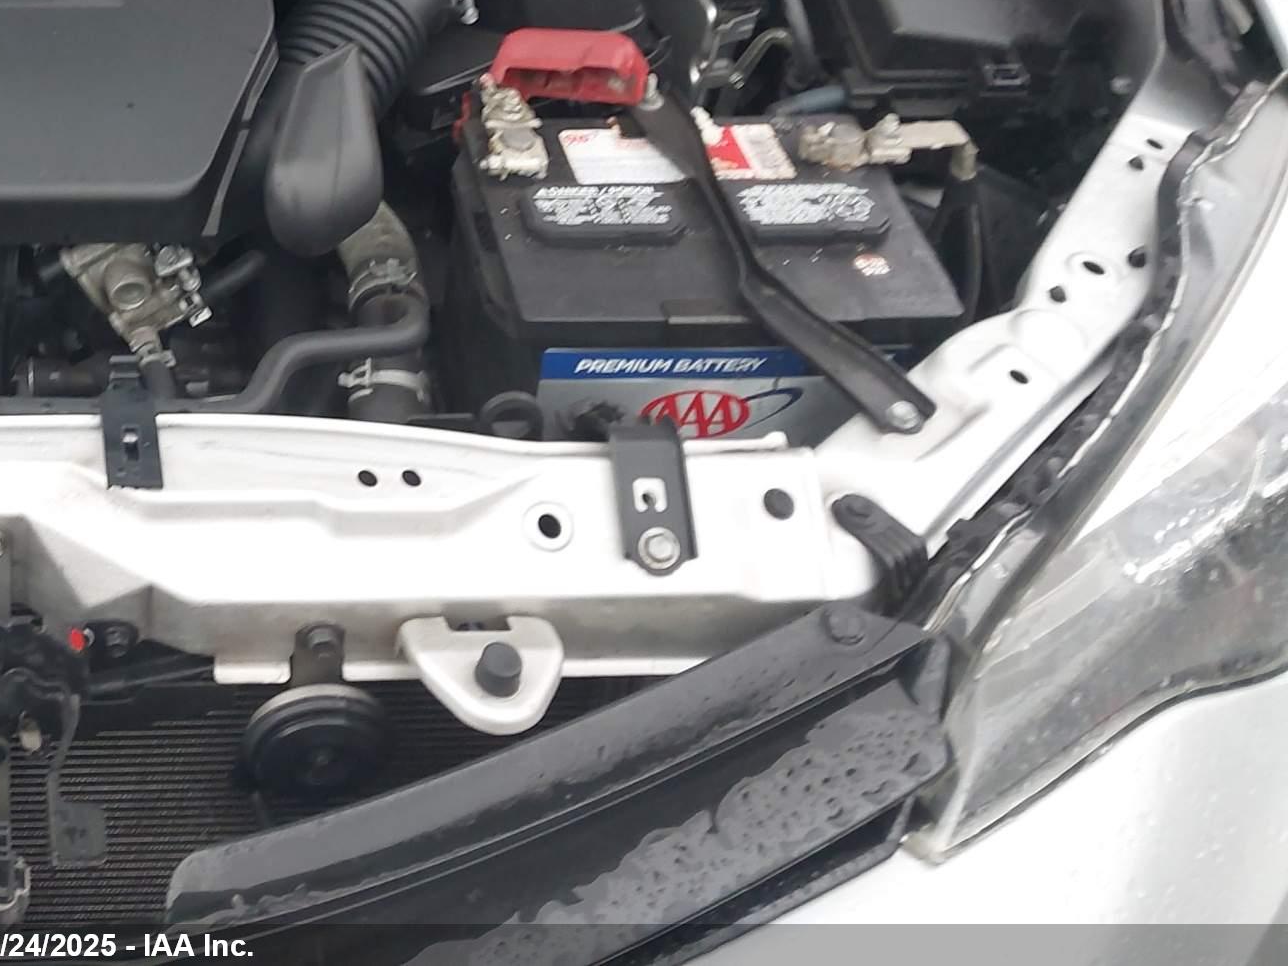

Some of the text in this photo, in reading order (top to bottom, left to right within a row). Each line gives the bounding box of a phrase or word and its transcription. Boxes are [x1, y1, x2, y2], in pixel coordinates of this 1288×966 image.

[574, 357, 767, 374] PREMIUM BATTERY
[644, 389, 748, 438] AAA
